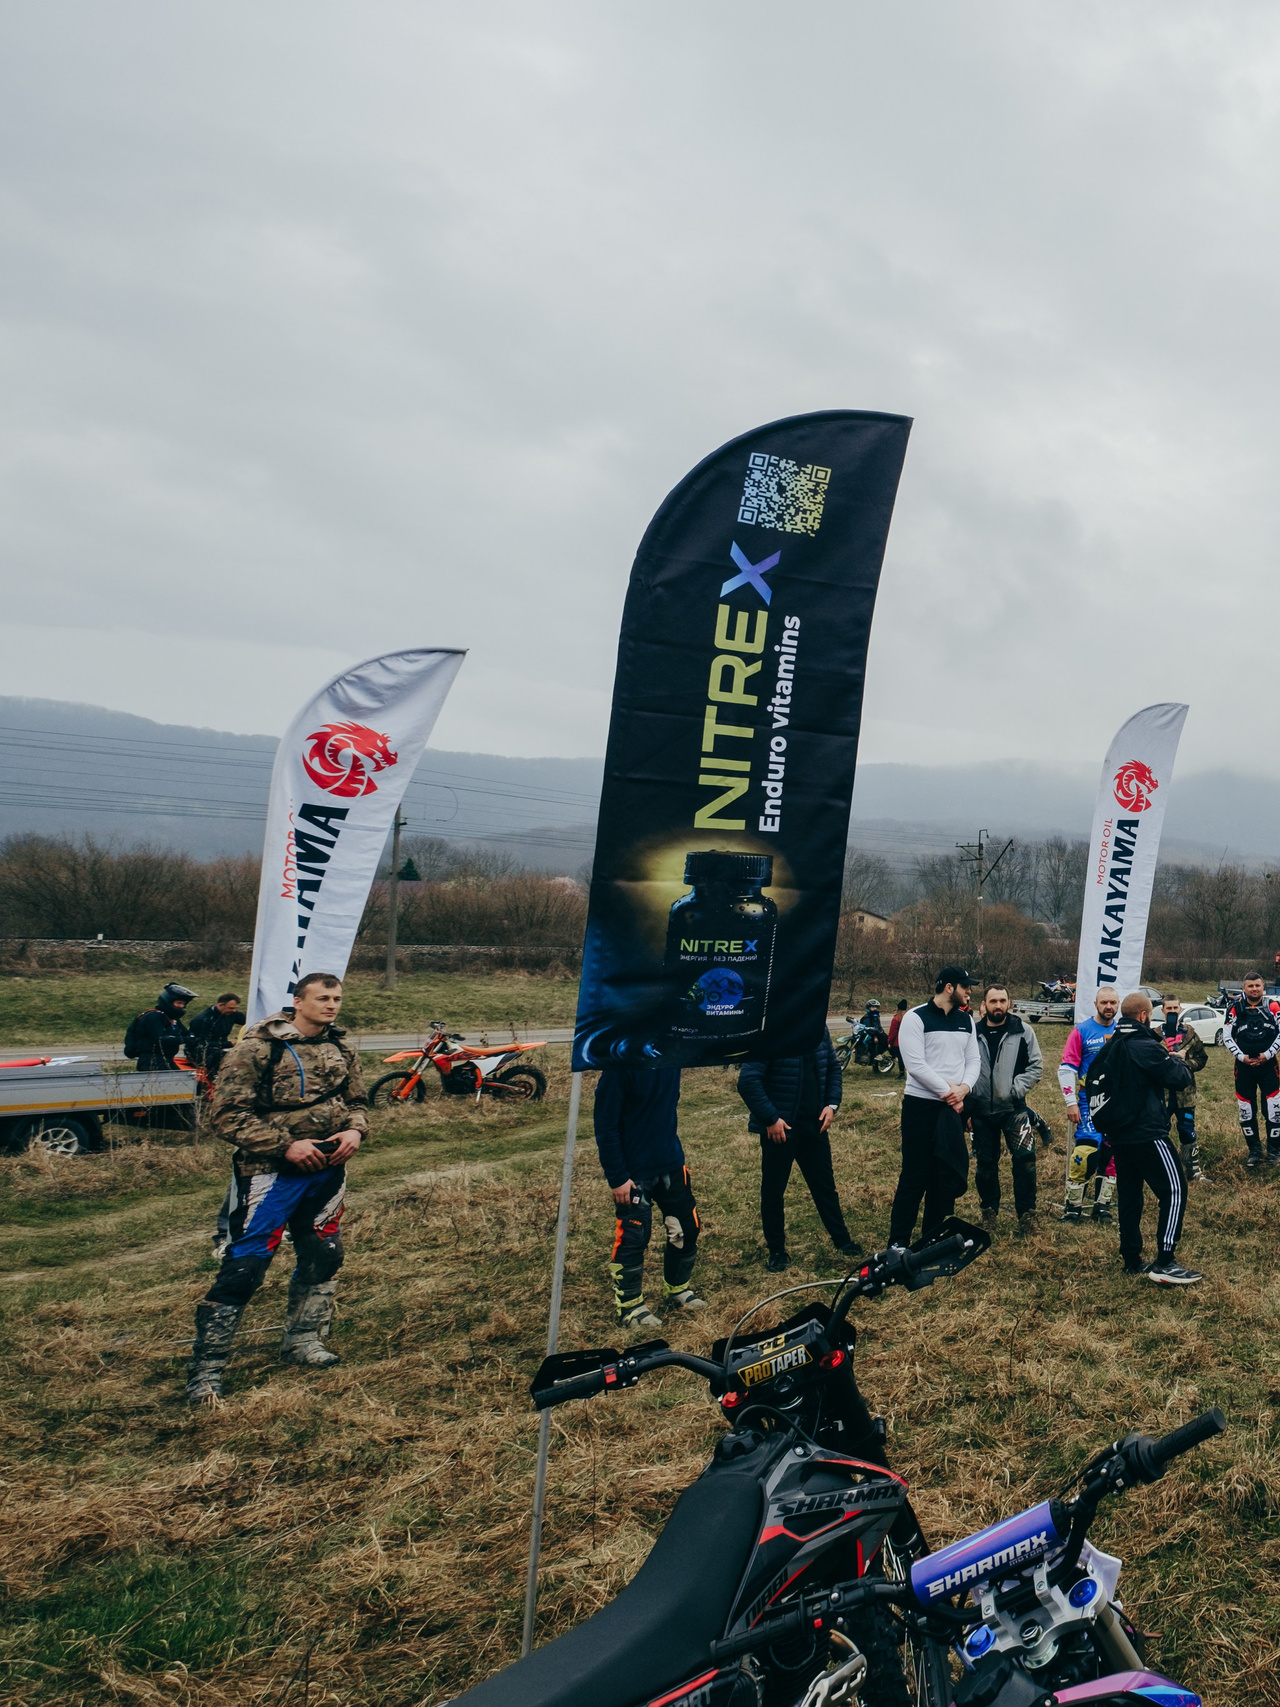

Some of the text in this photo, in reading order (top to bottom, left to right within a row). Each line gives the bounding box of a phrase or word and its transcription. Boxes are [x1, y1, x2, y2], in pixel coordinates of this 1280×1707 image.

[693, 540, 781, 830] NITREX
[758, 615, 800, 832] Enduro vitamins
[1096, 818, 1113, 885] MOTOR OIL
[1096, 818, 1140, 987] TAKAYAMA
[680, 939, 758, 953] NITREX
[744, 1346, 807, 1387] PROTAPER
[773, 1483, 901, 1519] SHARMAX
[924, 1530, 1048, 1598] SHARMAX
